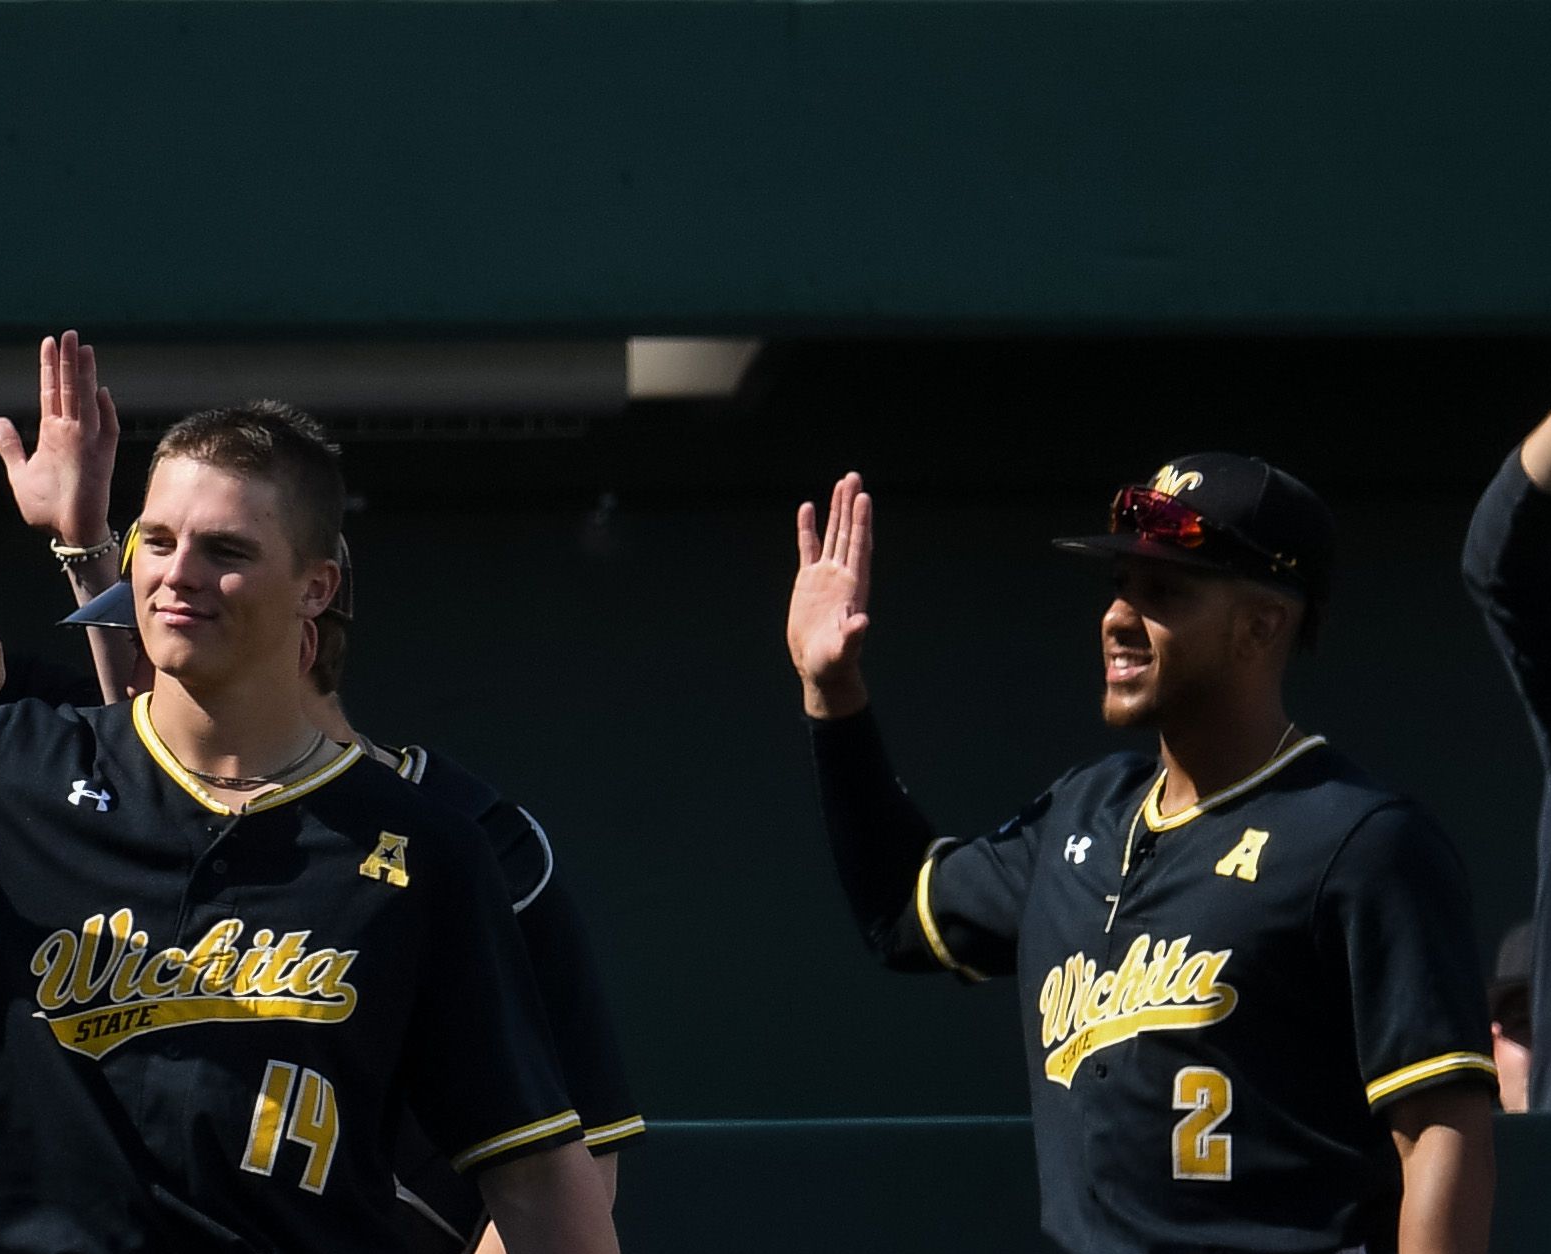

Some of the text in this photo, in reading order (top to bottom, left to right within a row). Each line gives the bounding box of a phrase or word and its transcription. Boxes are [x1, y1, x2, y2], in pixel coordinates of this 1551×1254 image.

[359, 830, 410, 888] A
[1215, 827, 1270, 882] A
[30, 907, 360, 1011] Wichita
[1039, 933, 1233, 1049] Wichita
[73, 1003, 158, 1044] STATE
[239, 1059, 340, 1196] 14
[1172, 1065, 1233, 1182] 2
